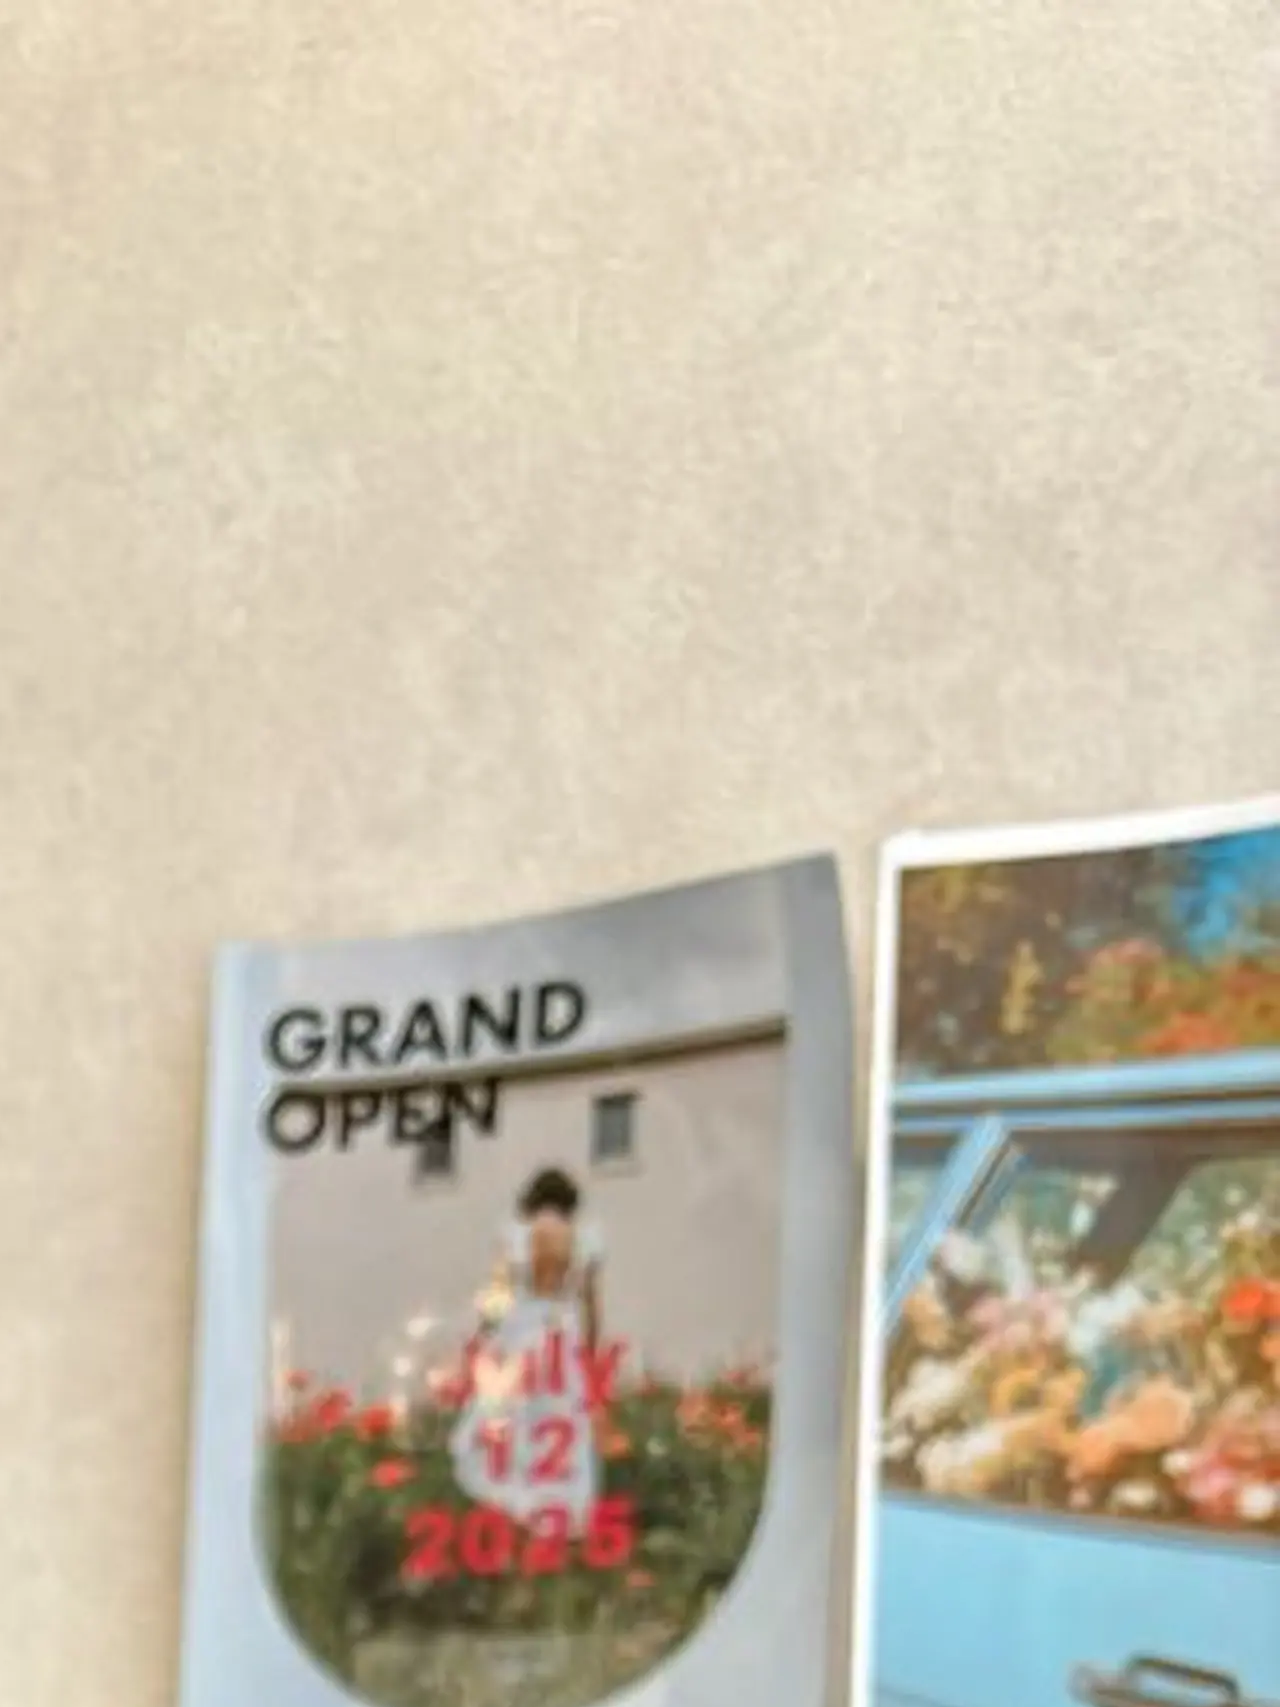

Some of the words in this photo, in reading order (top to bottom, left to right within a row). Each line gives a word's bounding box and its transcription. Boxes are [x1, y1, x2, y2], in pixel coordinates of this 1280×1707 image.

[264, 981, 586, 1073] GRAND
[264, 1076, 501, 1153] OPEN
[475, 1416, 576, 1483] 12
[403, 1498, 634, 1580] 2025
